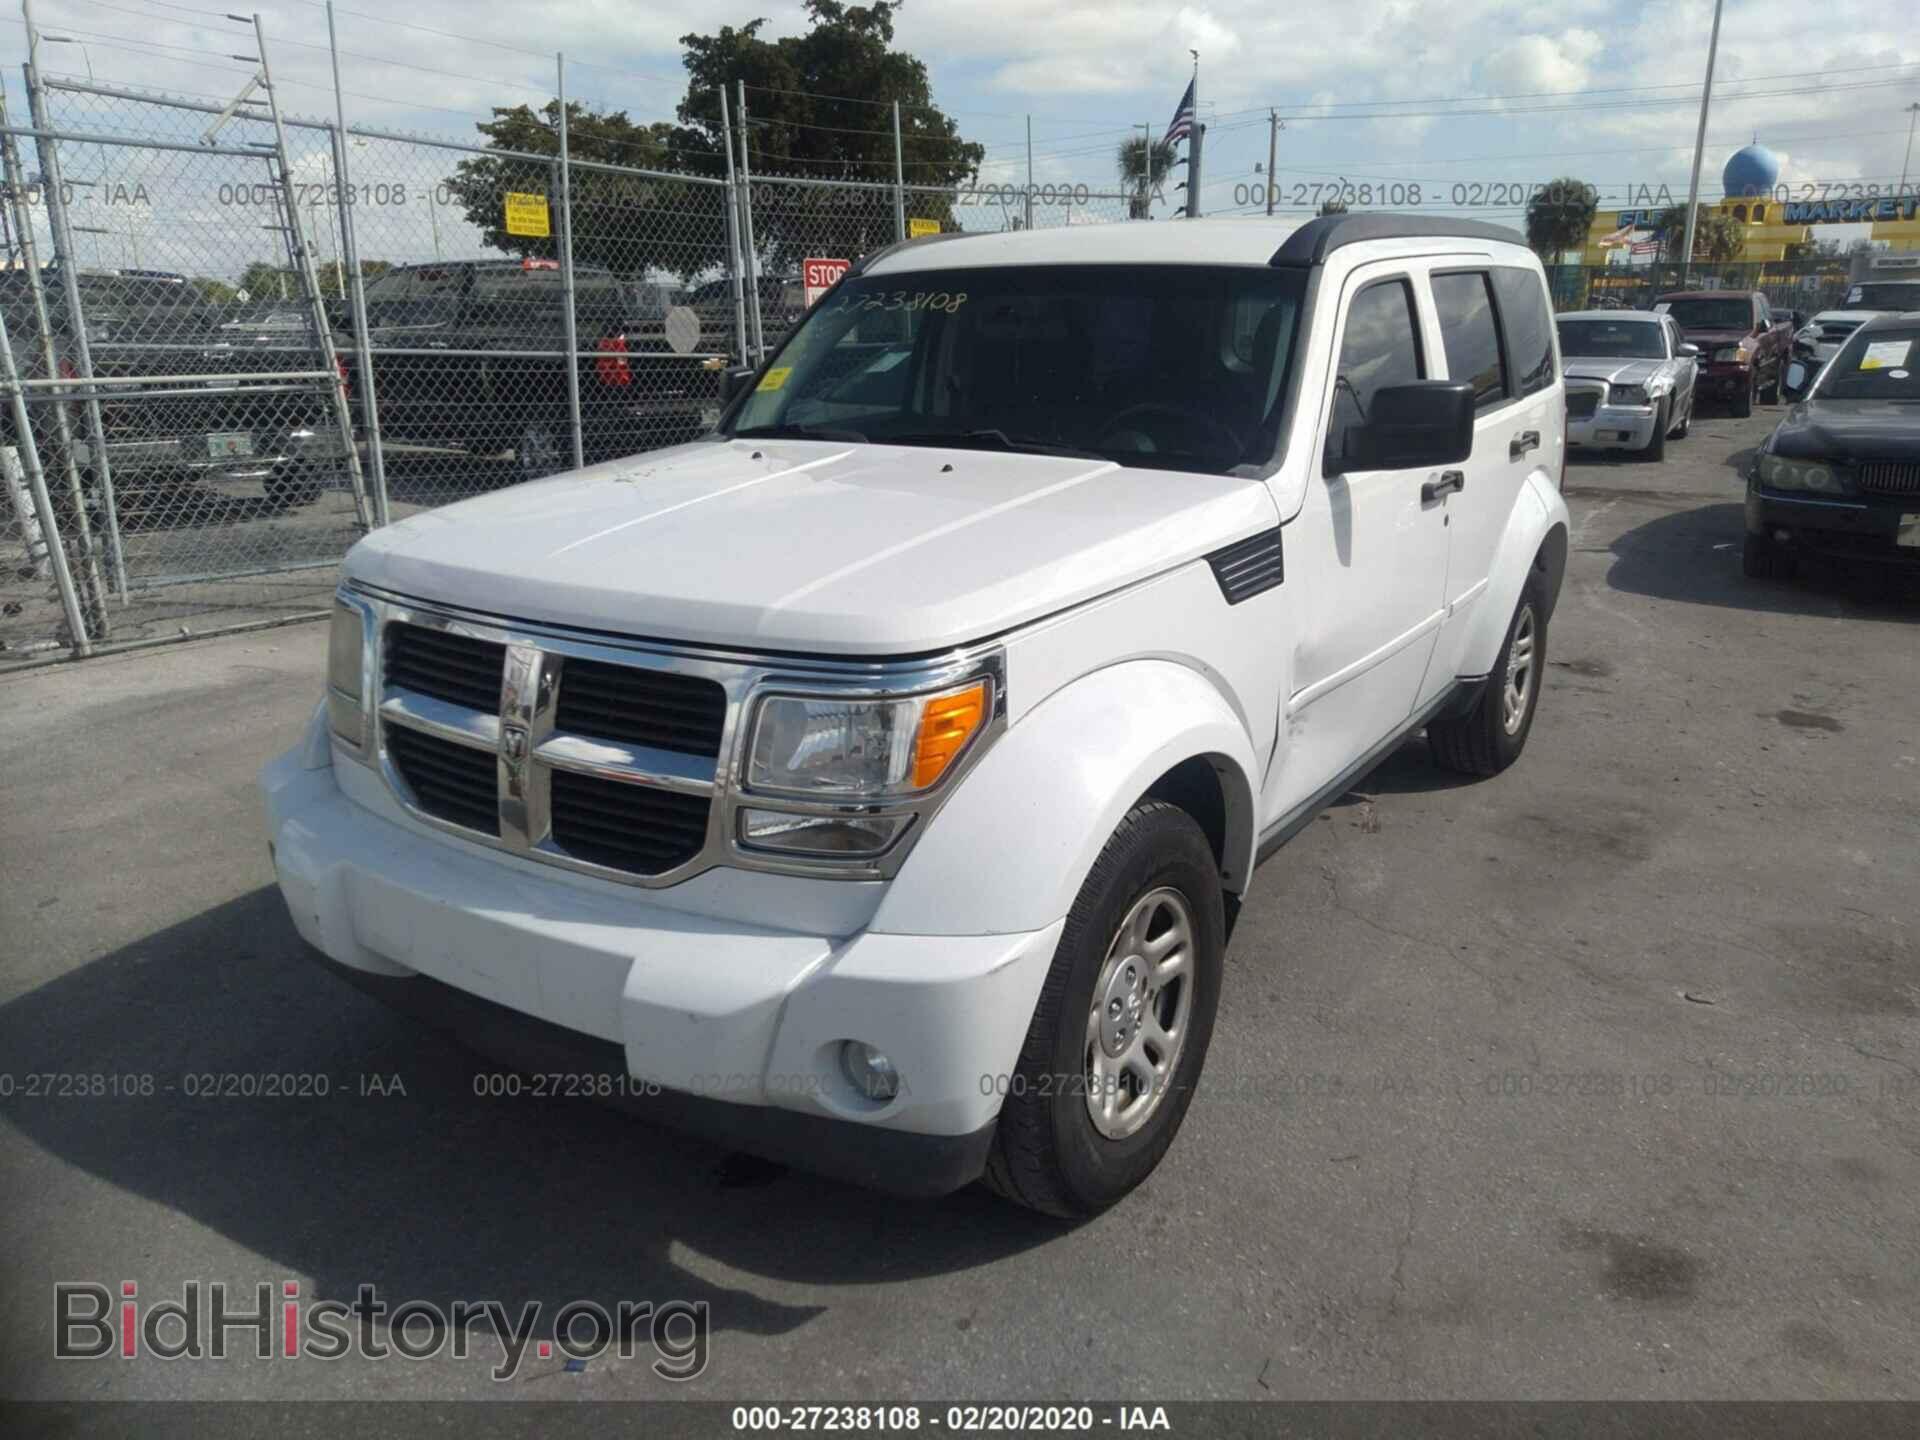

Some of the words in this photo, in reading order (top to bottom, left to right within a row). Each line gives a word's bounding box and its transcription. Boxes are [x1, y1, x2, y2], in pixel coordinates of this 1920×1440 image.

[1783, 198, 1919, 226] MARKET
[808, 264, 847, 286] STOP
[834, 291, 968, 313] 27238108
